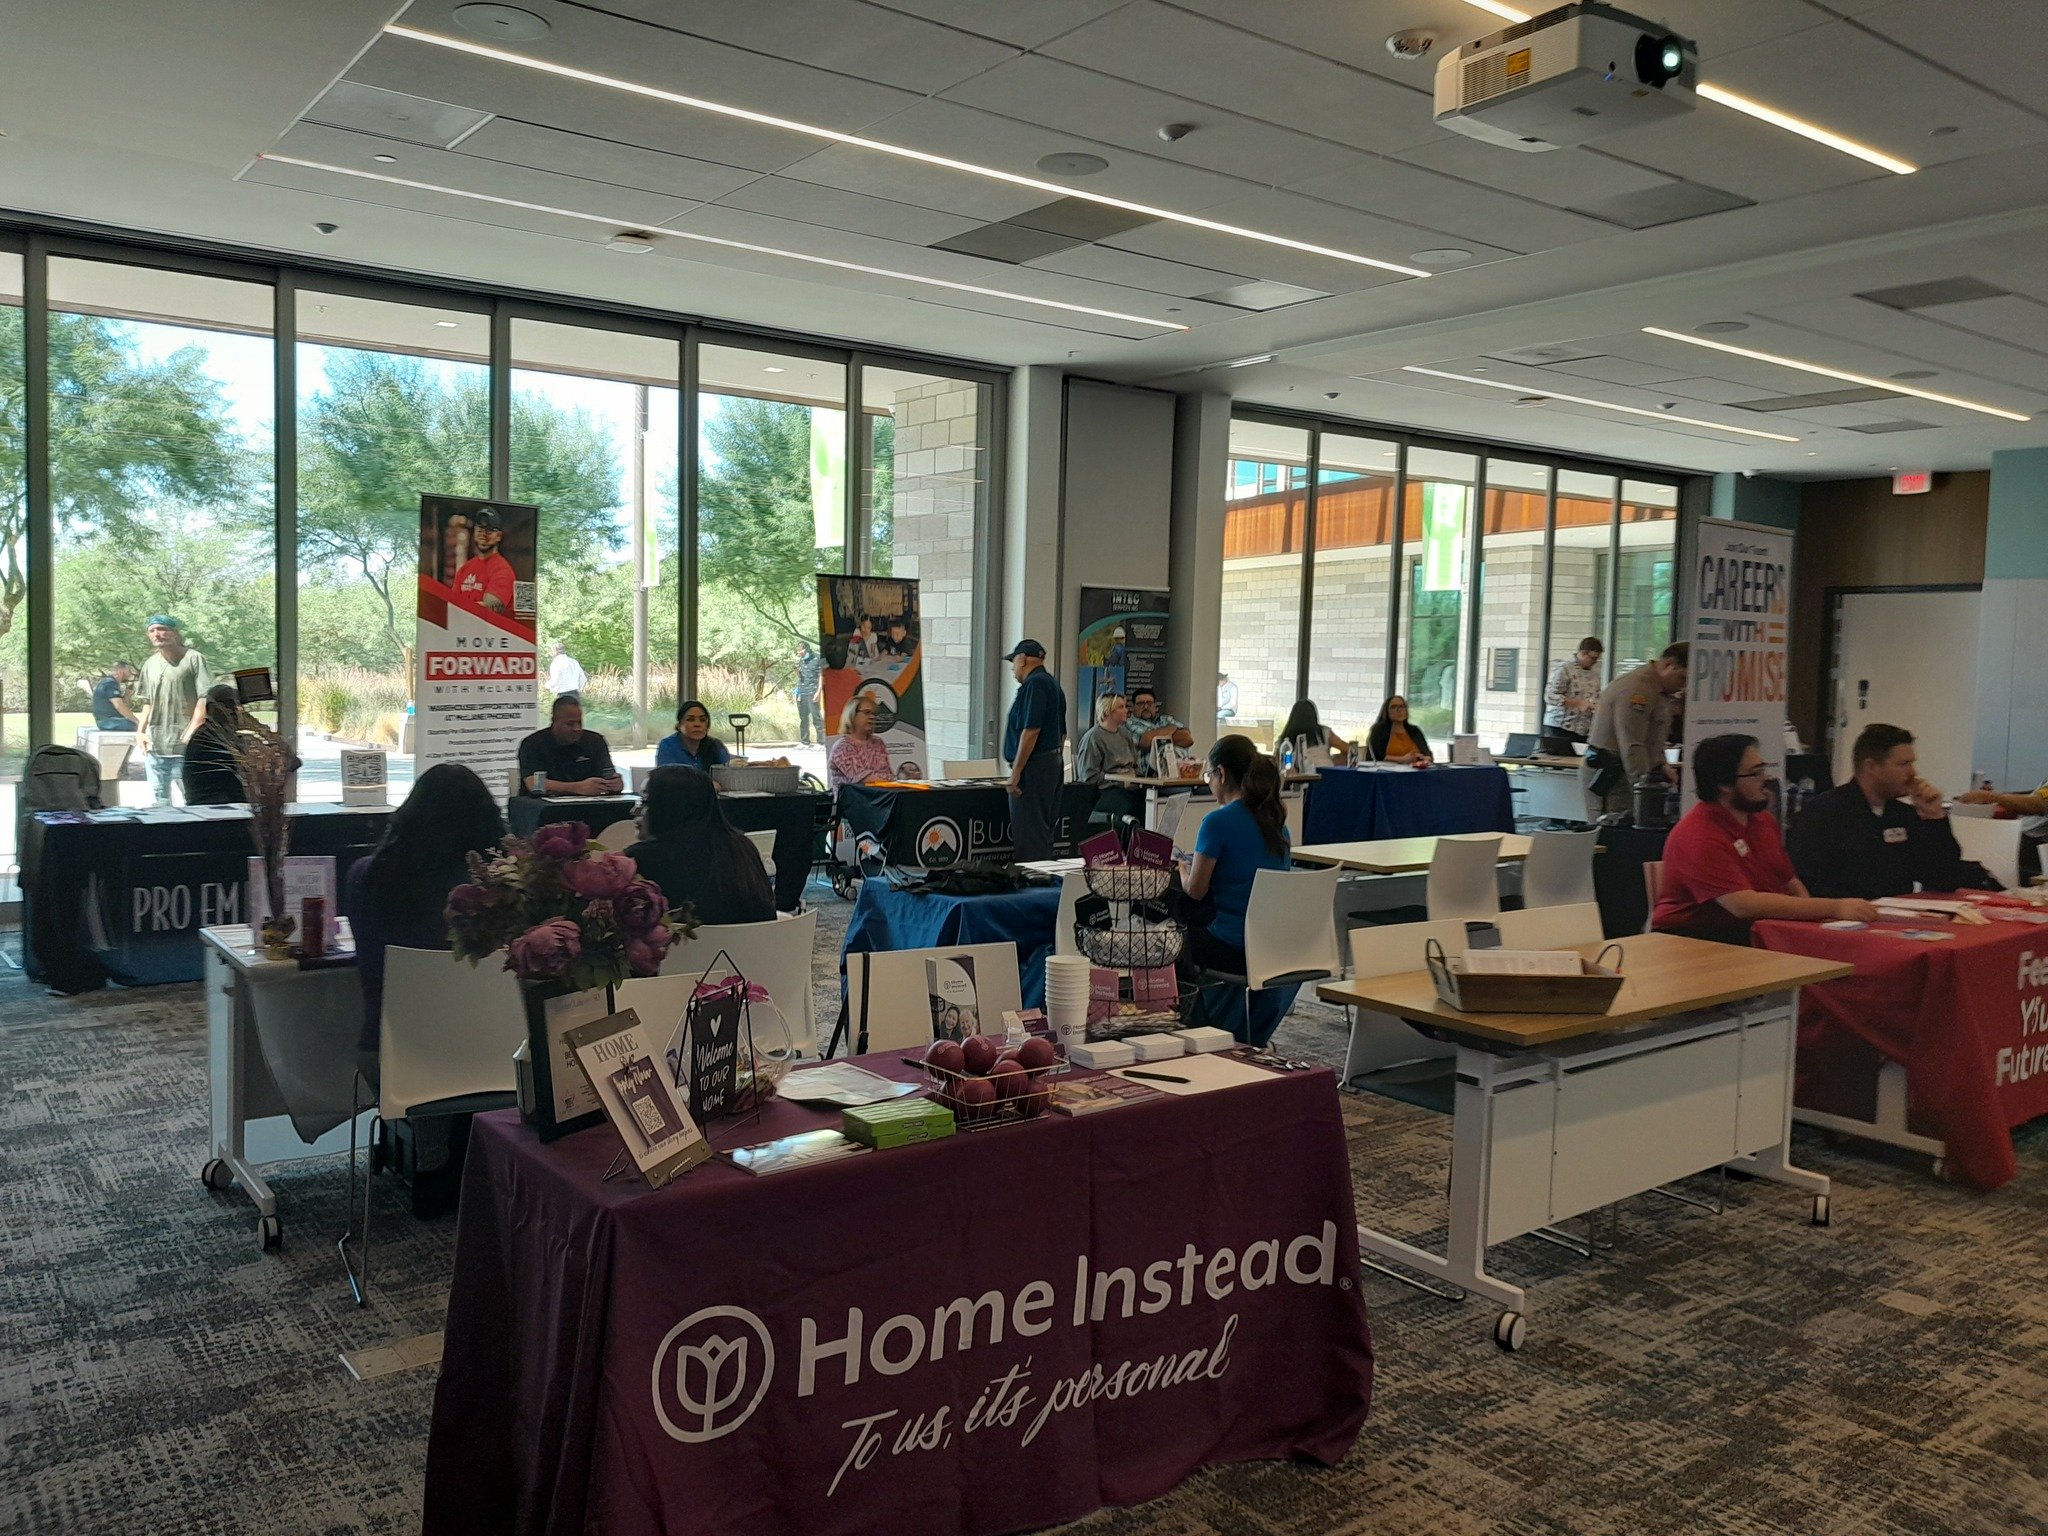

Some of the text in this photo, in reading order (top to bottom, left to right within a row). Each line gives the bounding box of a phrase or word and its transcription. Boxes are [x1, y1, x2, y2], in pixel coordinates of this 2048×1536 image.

[1702, 555, 1785, 614] CAREERS
[456, 637, 509, 648] MOVE
[1723, 620, 1765, 642] WITH
[429, 656, 535, 676] FORWARD
[1695, 648, 1785, 703] PROMISE
[132, 885, 191, 933] PRO
[593, 1033, 639, 1063] HOME
[695, 1041, 734, 1075] Welcome
[700, 1065, 730, 1092] TO OUR
[702, 1088, 725, 1112] HOME
[798, 1280, 1055, 1397] Home
[827, 1313, 1239, 1497] To us, it's personal
